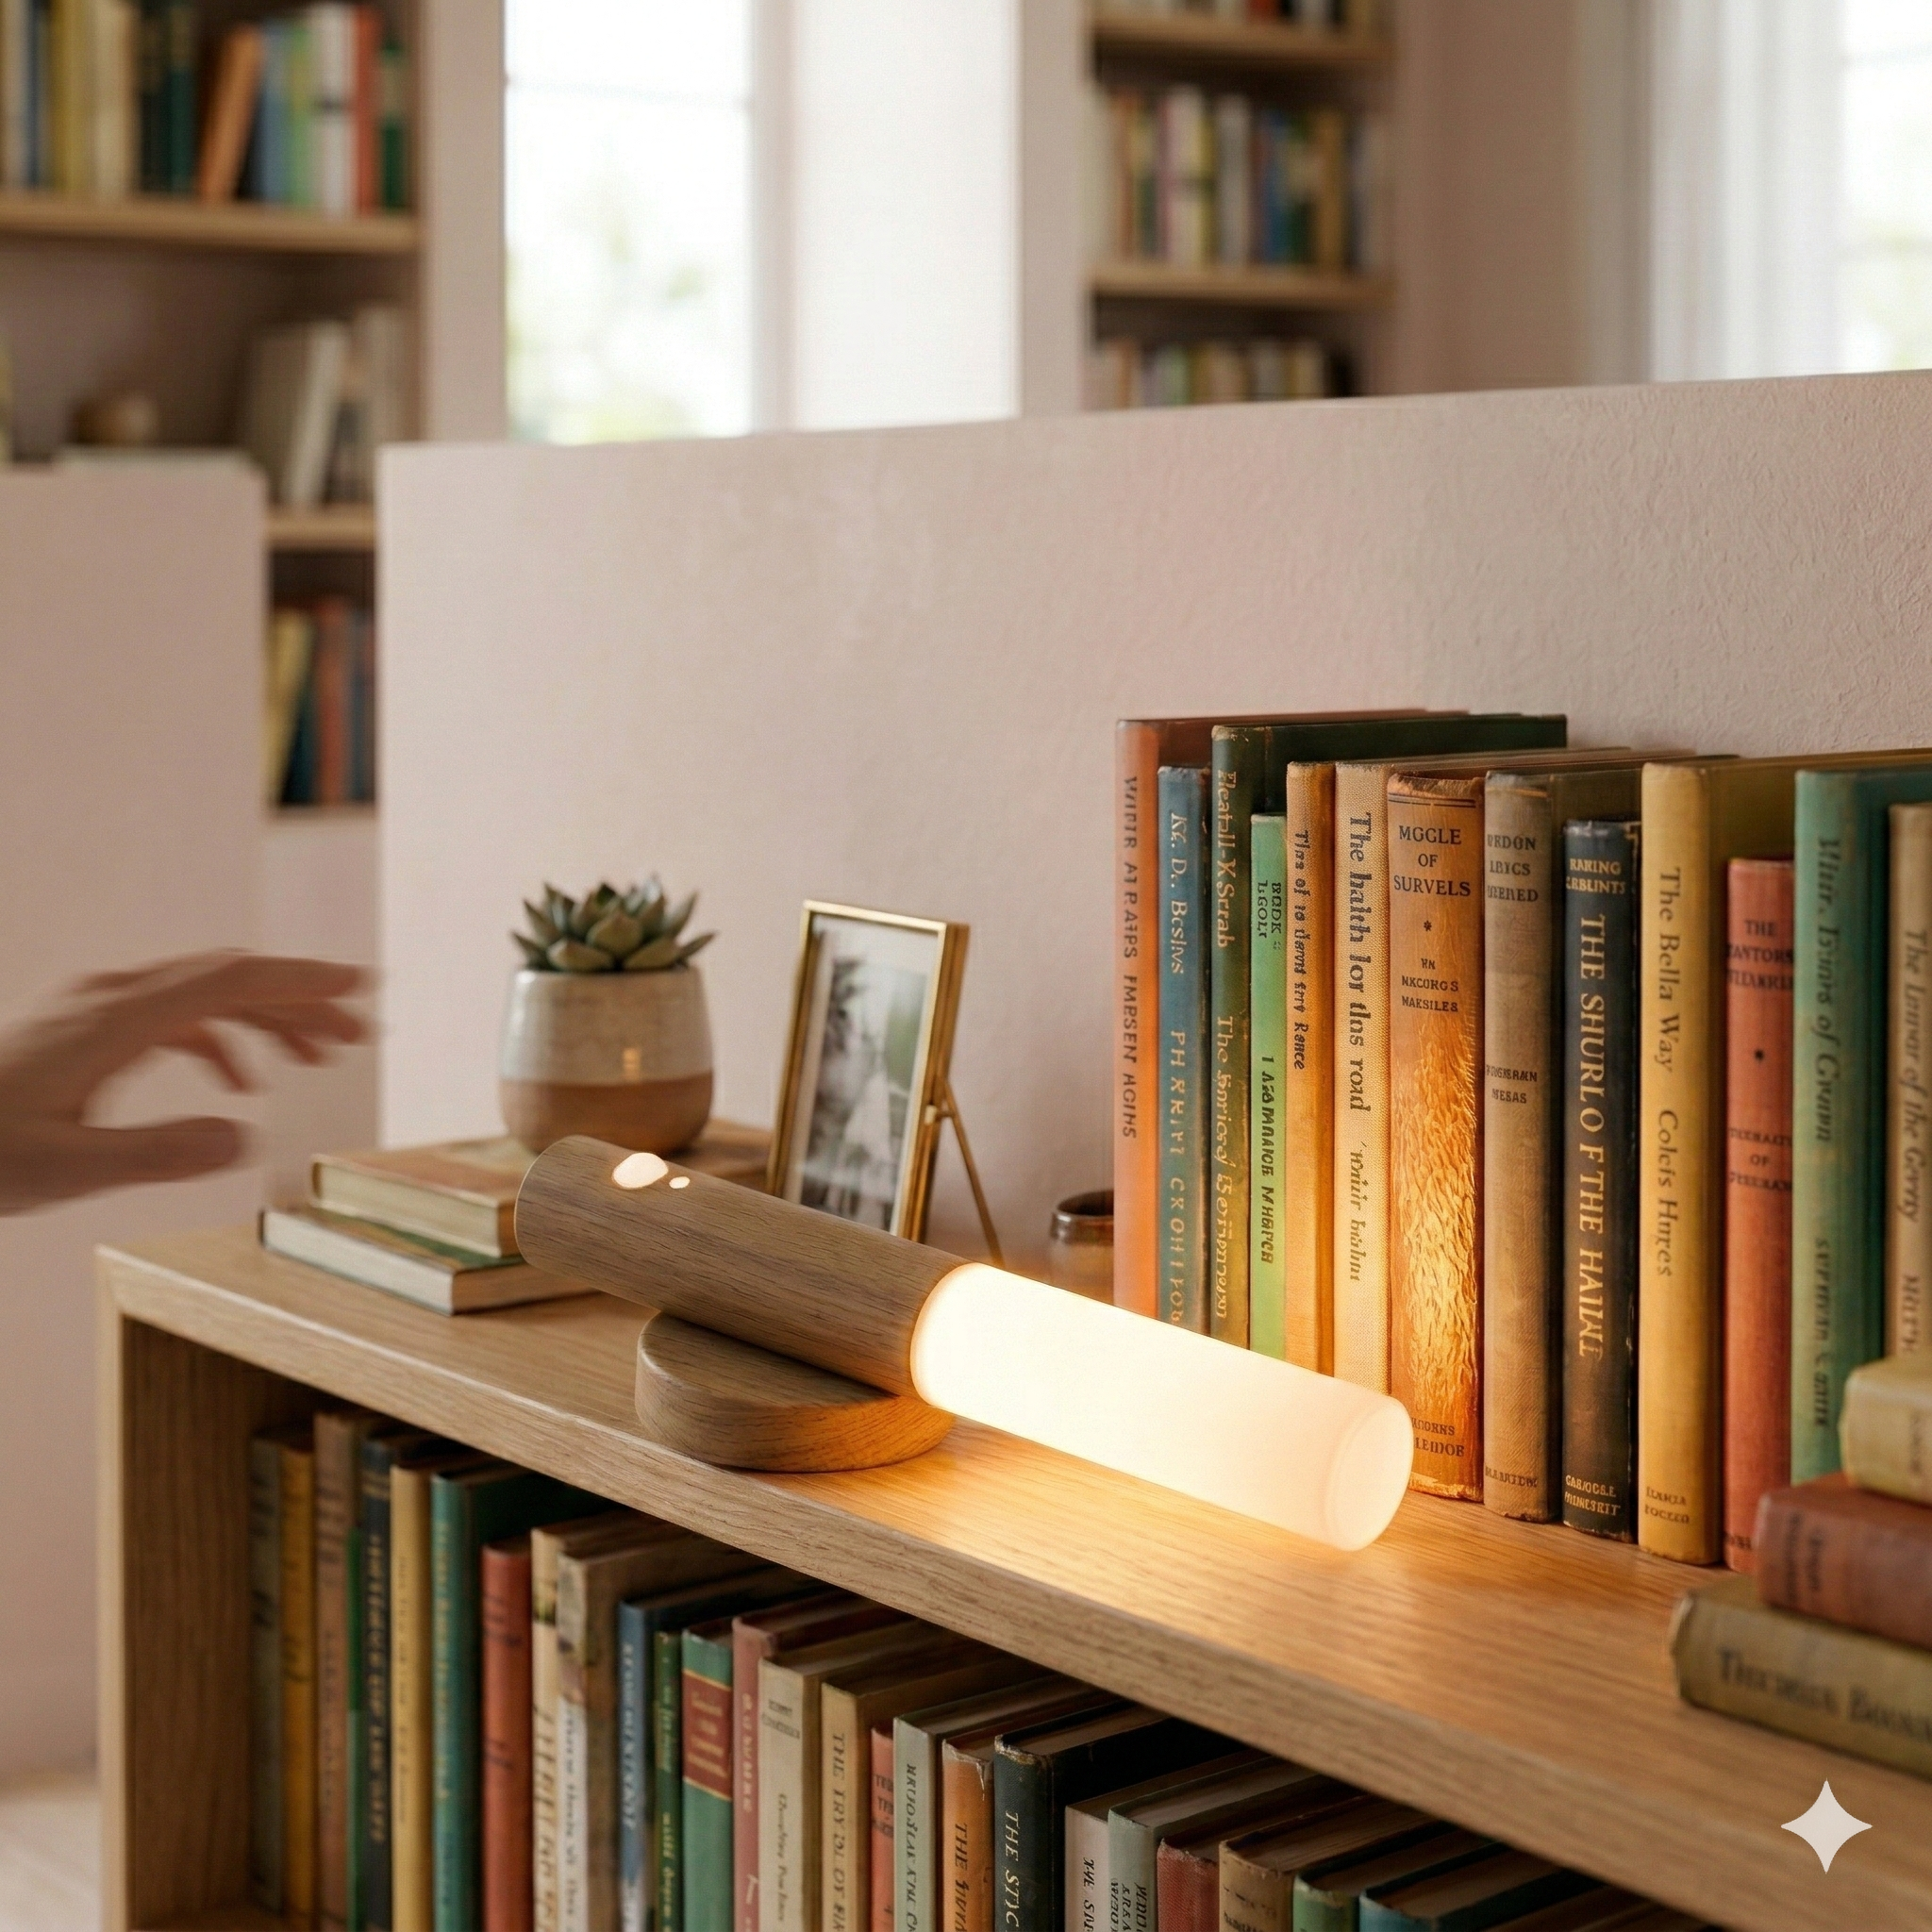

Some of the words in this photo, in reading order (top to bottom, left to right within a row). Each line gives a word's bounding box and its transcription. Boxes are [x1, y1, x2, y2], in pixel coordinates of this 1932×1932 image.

[1350, 812, 1373, 862] The
[1418, 853, 1438, 867] OF
[1393, 874, 1471, 897] SURVELS
[1659, 867, 1681, 922] The
[1579, 913, 1607, 980] THE
[1659, 934, 1680, 1001] Bella
[1216, 1016, 1234, 1062] The
[1654, 1012, 1681, 1073] Way
[955, 1823, 968, 1871] THE
[1006, 1810, 1020, 1861] THE
